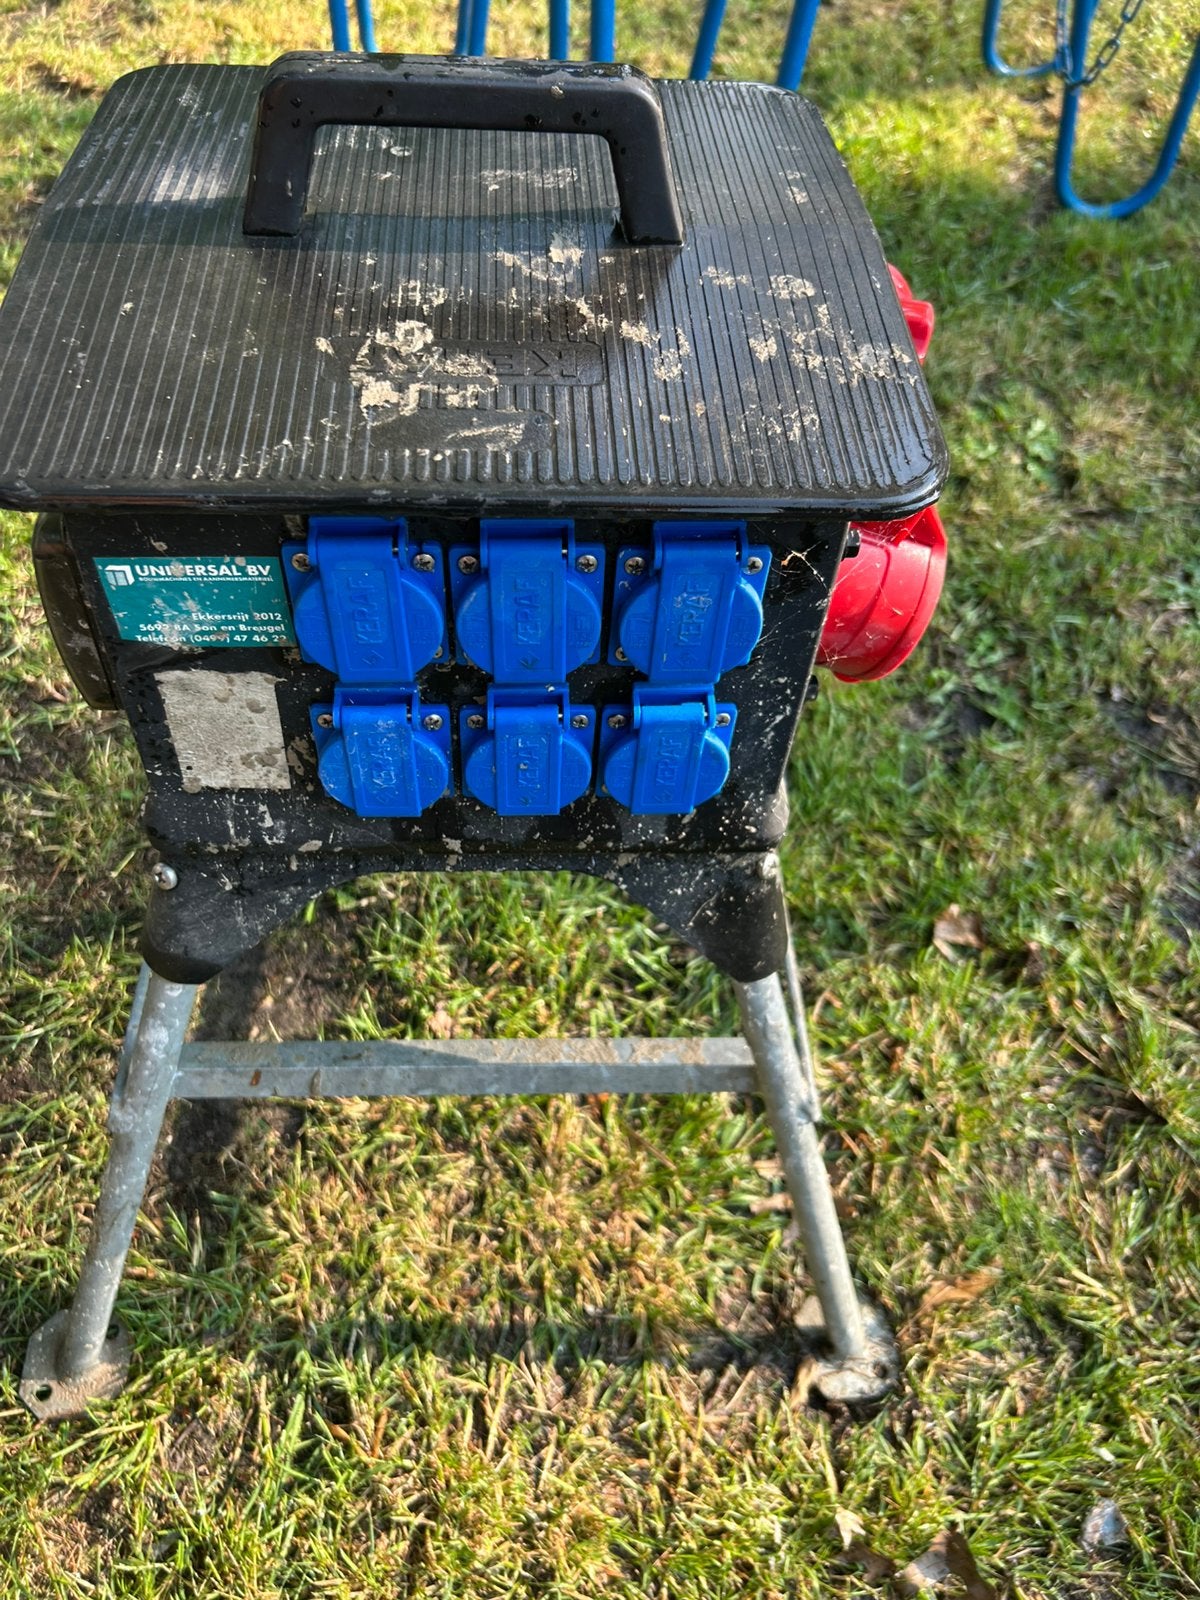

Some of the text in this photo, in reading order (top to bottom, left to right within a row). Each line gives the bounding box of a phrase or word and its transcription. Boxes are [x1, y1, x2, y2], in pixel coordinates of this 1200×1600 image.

[247, 565, 271, 577] BV
[191, 612, 283, 622] Ekkersrijt 2012
[346, 576, 383, 644] KERAF
[512, 577, 541, 647] KERAF
[677, 579, 711, 647] KERAF
[193, 623, 218, 632] Son
[239, 623, 286, 634] Breugel
[233, 634, 248, 642] 47
[252, 634, 269, 642] 46
[655, 736, 683, 786] KERAF
